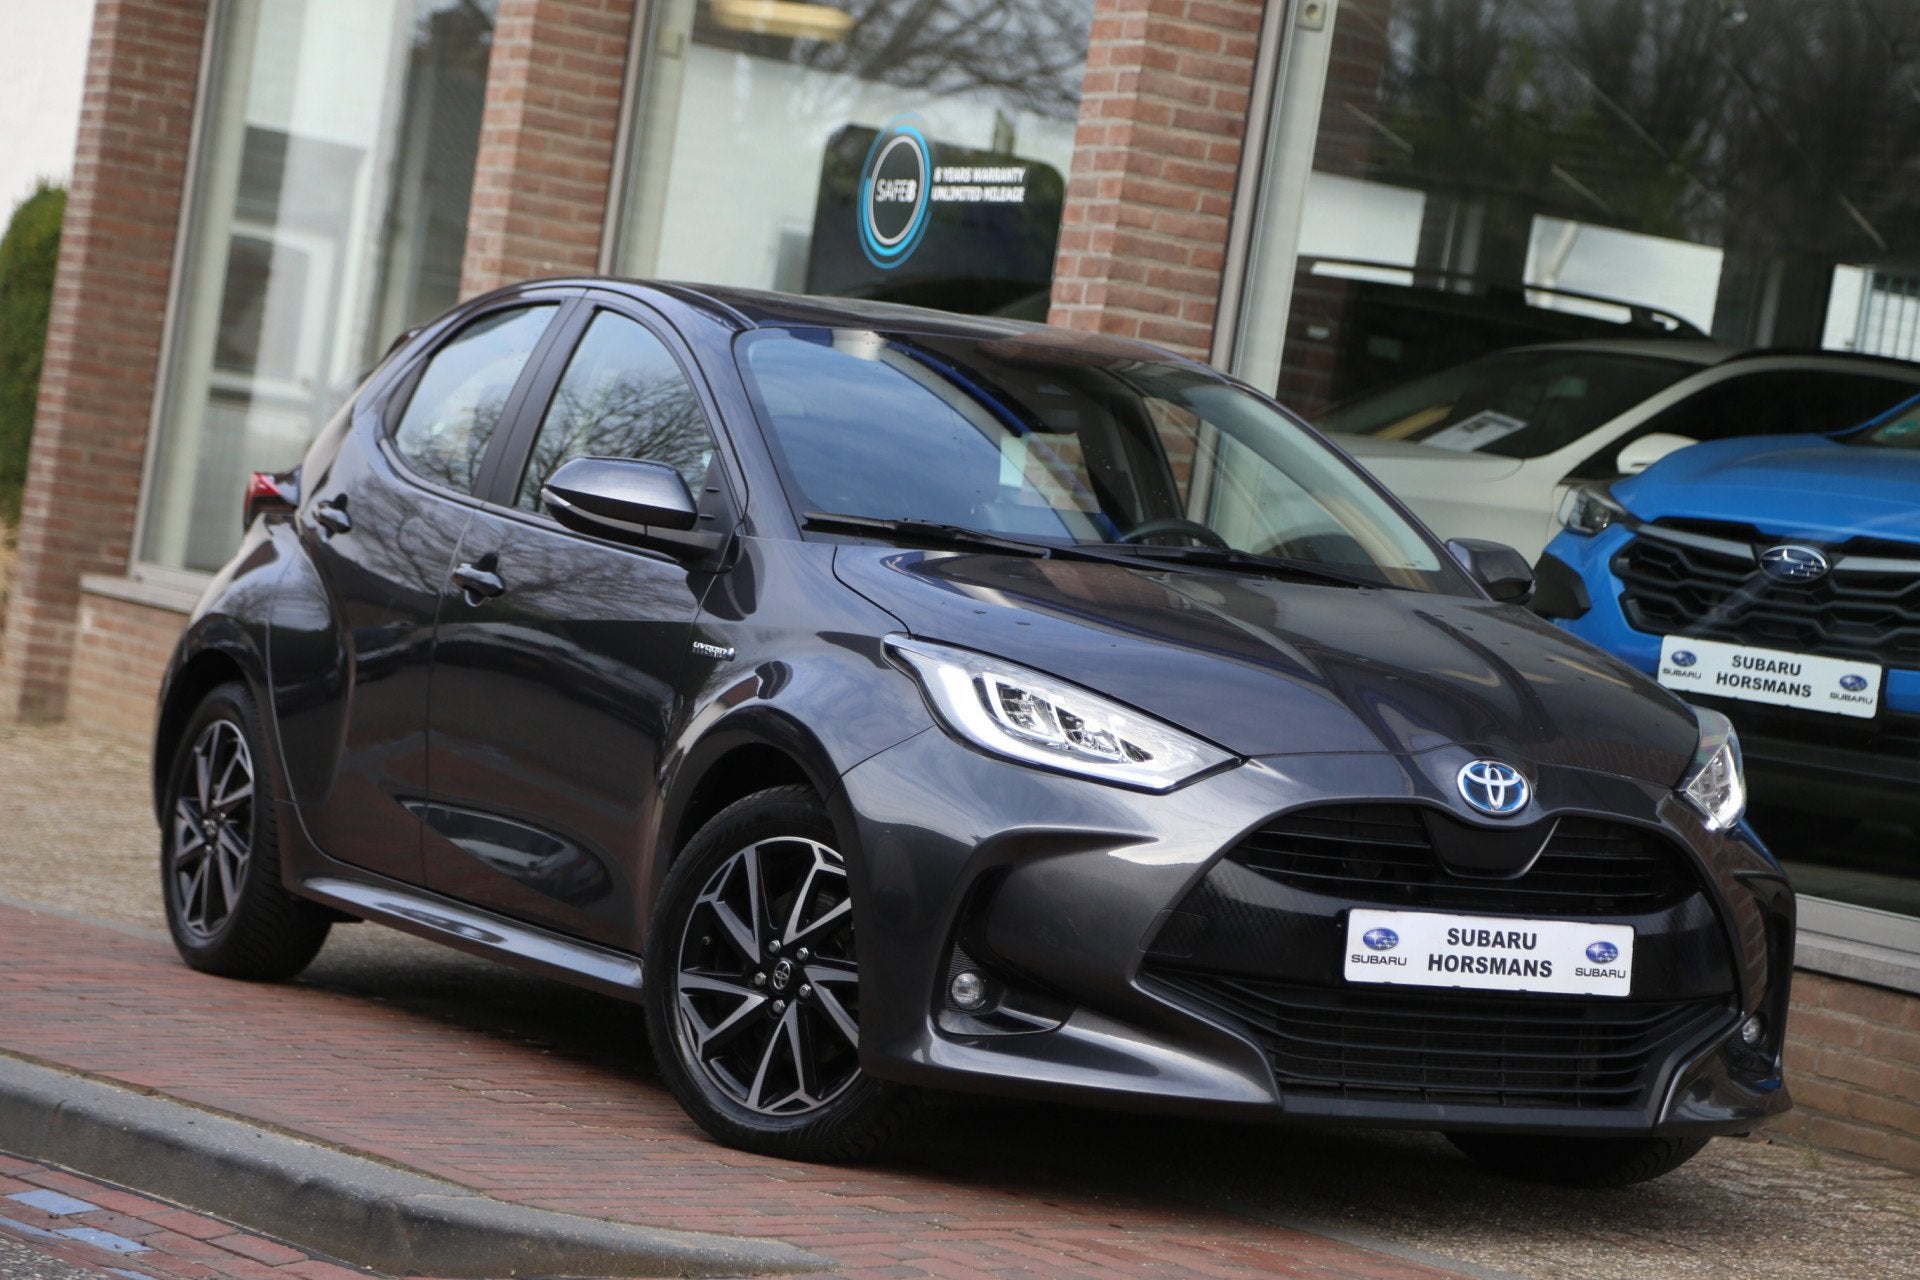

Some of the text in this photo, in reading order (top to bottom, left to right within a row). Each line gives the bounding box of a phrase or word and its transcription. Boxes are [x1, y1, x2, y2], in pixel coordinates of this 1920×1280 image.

[942, 167, 973, 183] YEARS
[972, 167, 1026, 184] WARRANTY
[931, 185, 1025, 203] UNLIMITED MILEAGE
[1662, 668, 1702, 680] SUBARU
[1732, 655, 1802, 676] SUBARU
[1716, 672, 1812, 698] HORSMANS
[1829, 691, 1873, 705] SUBARU
[1447, 928, 1538, 950] SUBARU
[1351, 954, 1407, 966] SUBARU
[1427, 953, 1553, 978] HORSMANS
[1575, 967, 1626, 979] SUBARU
